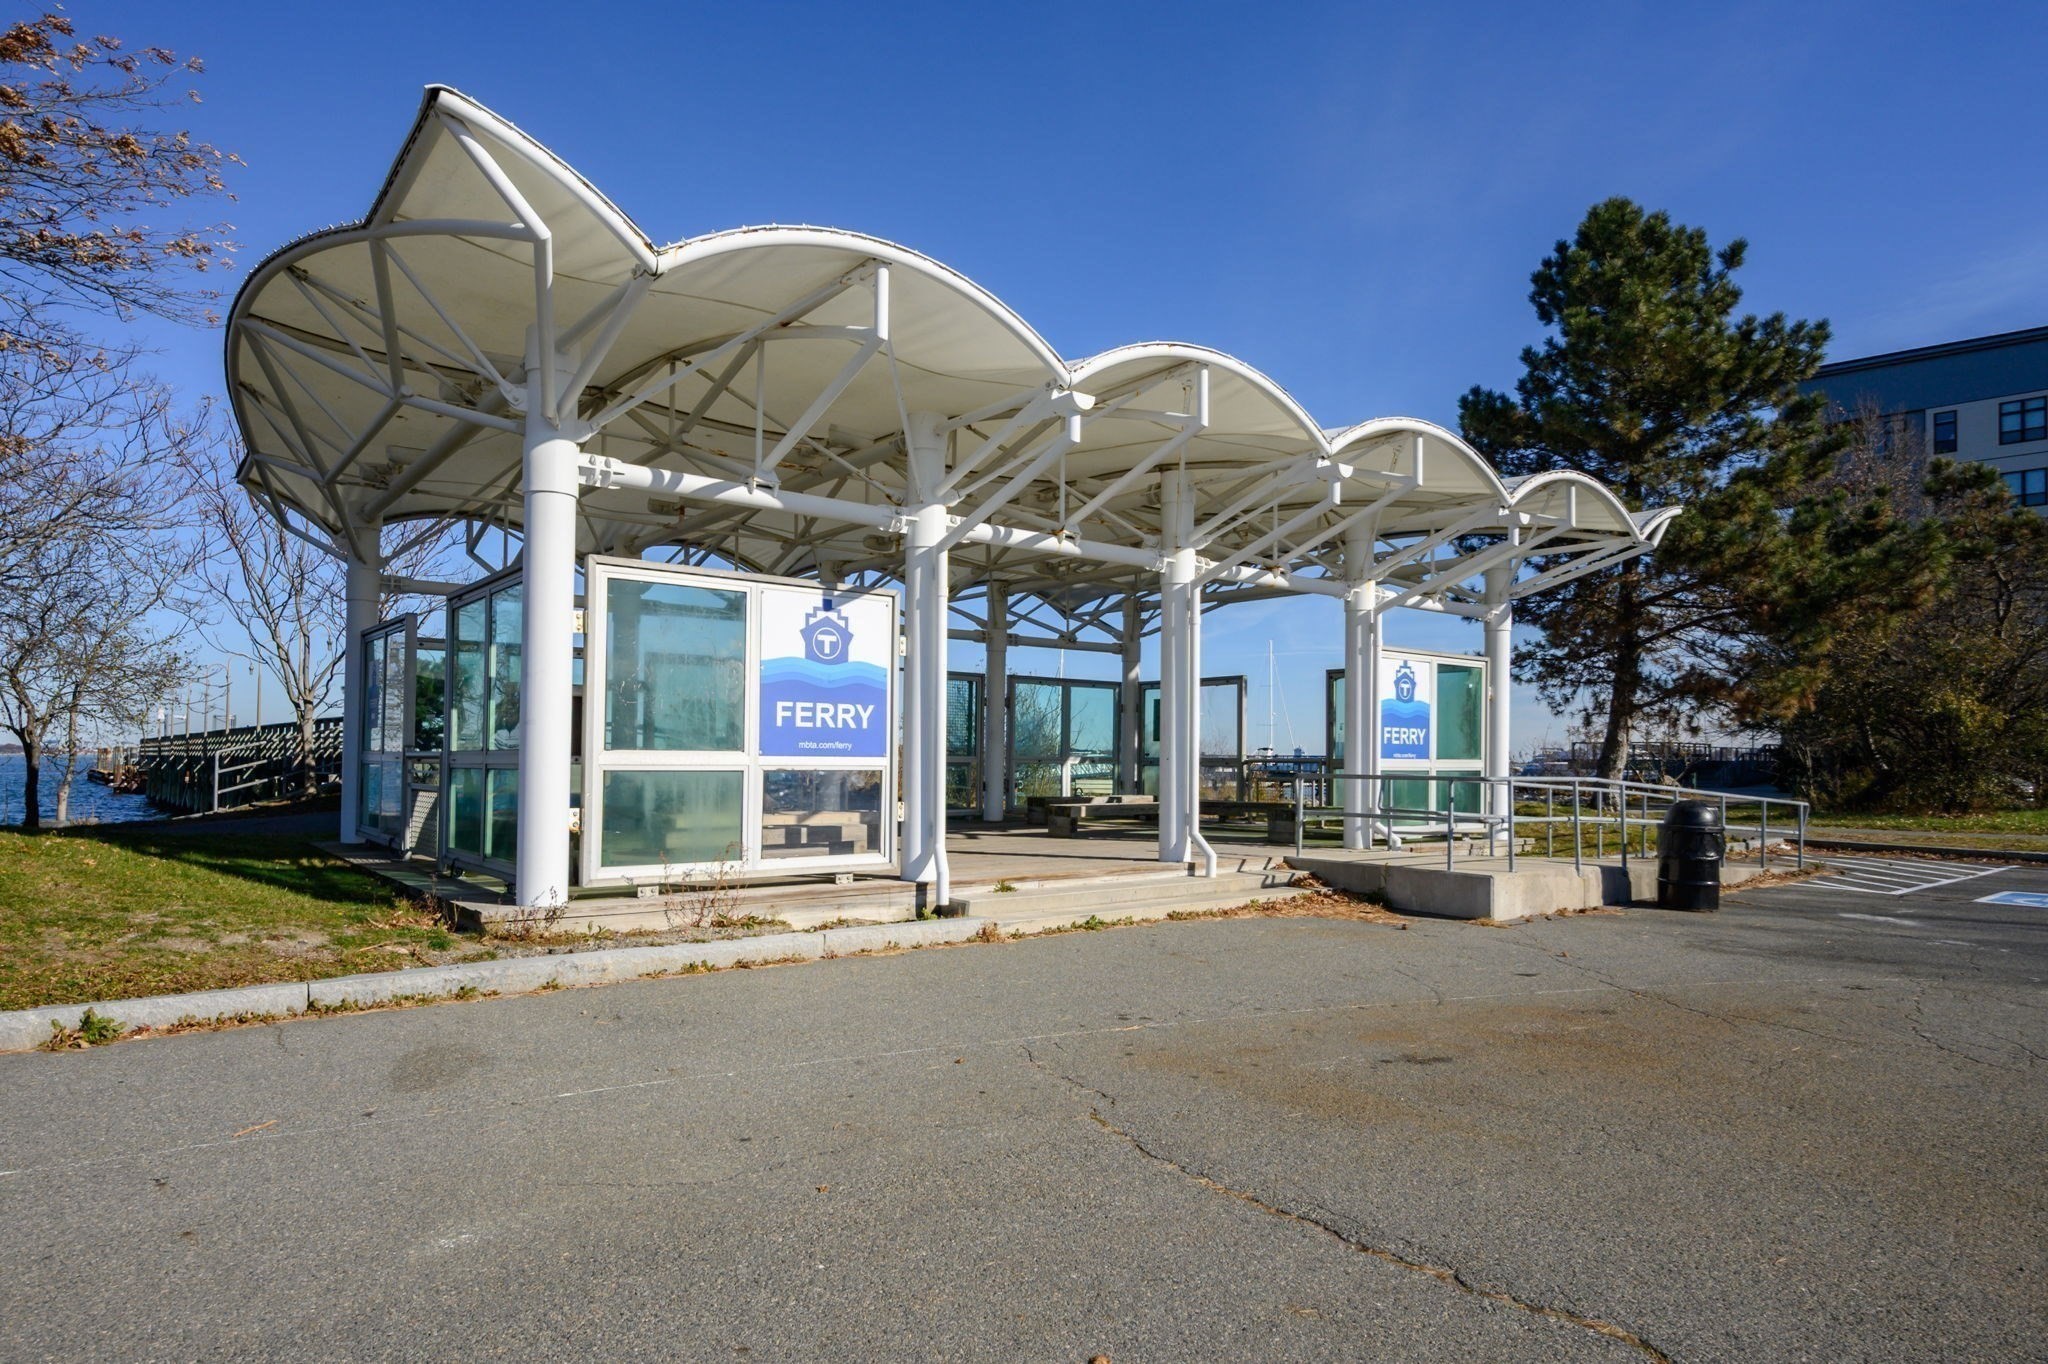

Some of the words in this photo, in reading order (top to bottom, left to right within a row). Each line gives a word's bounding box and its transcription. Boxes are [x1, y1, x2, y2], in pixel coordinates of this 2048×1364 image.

[817, 634, 837, 654] T
[776, 701, 875, 729] FERRY
[1383, 727, 1426, 745] FERRY
[798, 741, 853, 751] mbta.com/ferry
